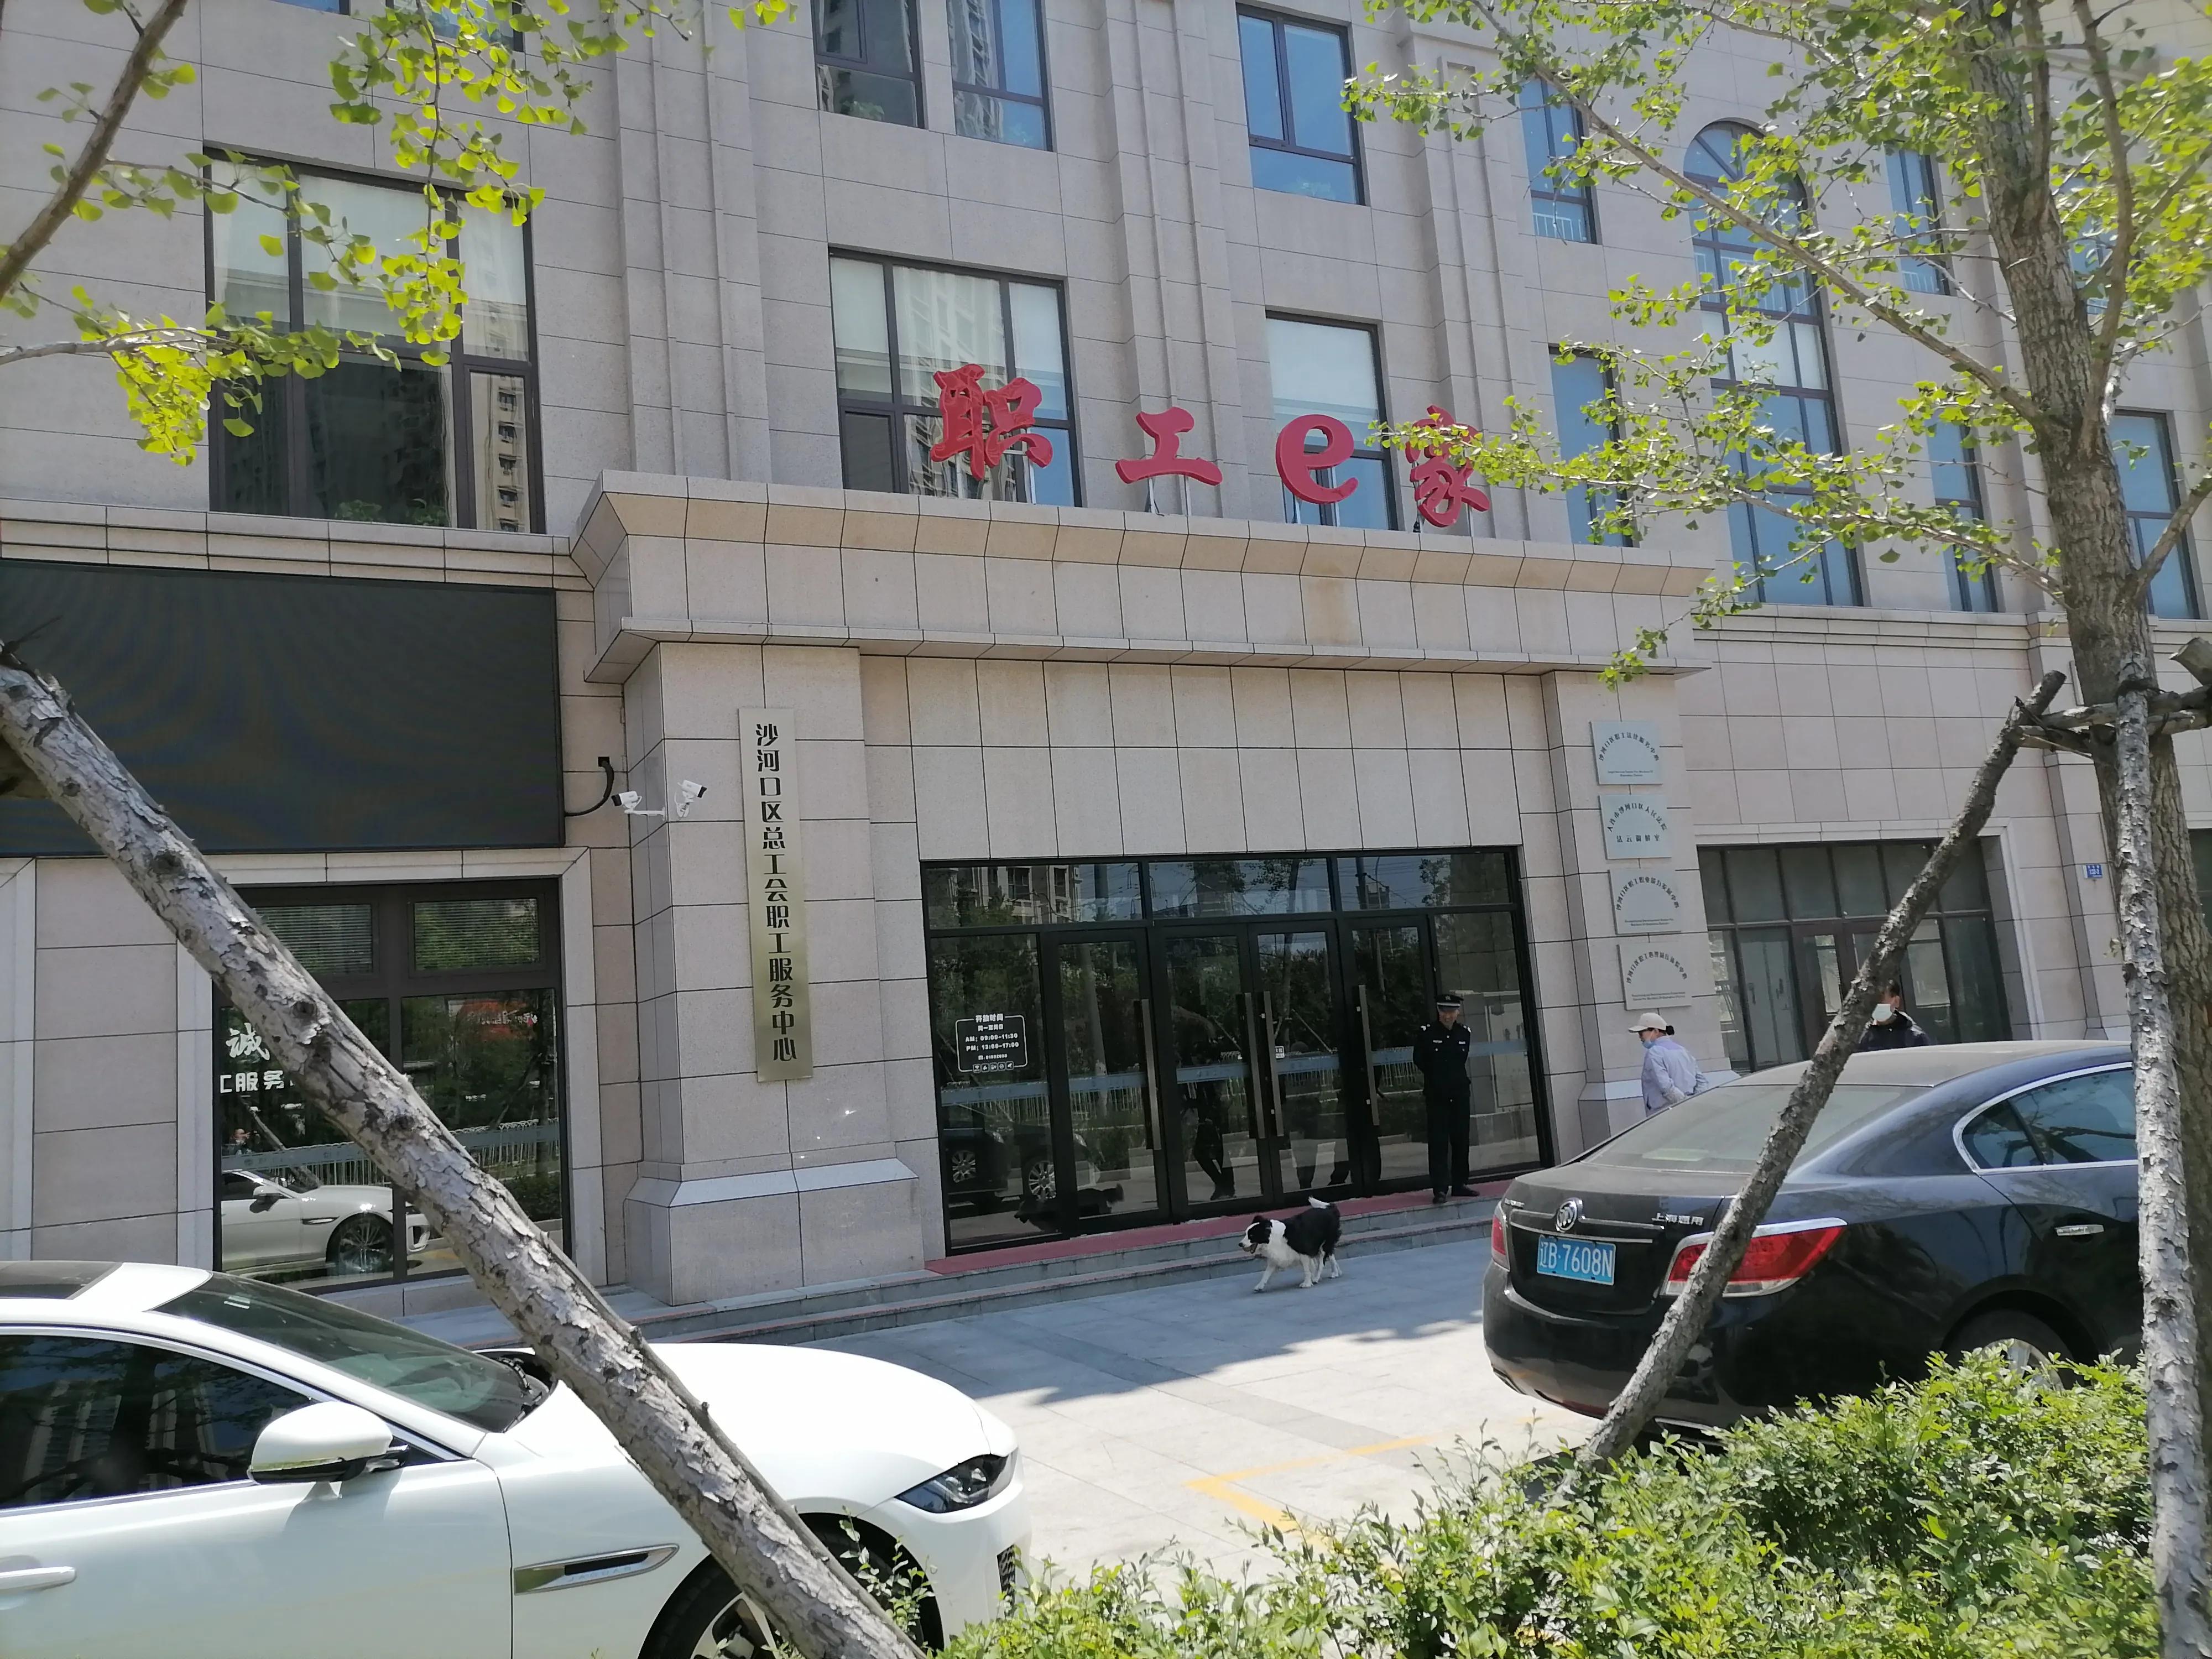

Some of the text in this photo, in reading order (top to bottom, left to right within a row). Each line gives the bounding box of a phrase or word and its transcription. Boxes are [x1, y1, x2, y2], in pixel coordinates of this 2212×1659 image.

[930, 363, 1490, 528] 职工e家
[755, 723, 797, 1061] 沙河口区总工会职工服务中心
[975, 1013, 1004, 1022] 开放时间
[1651, 1212, 1704, 1226] 上海通用
